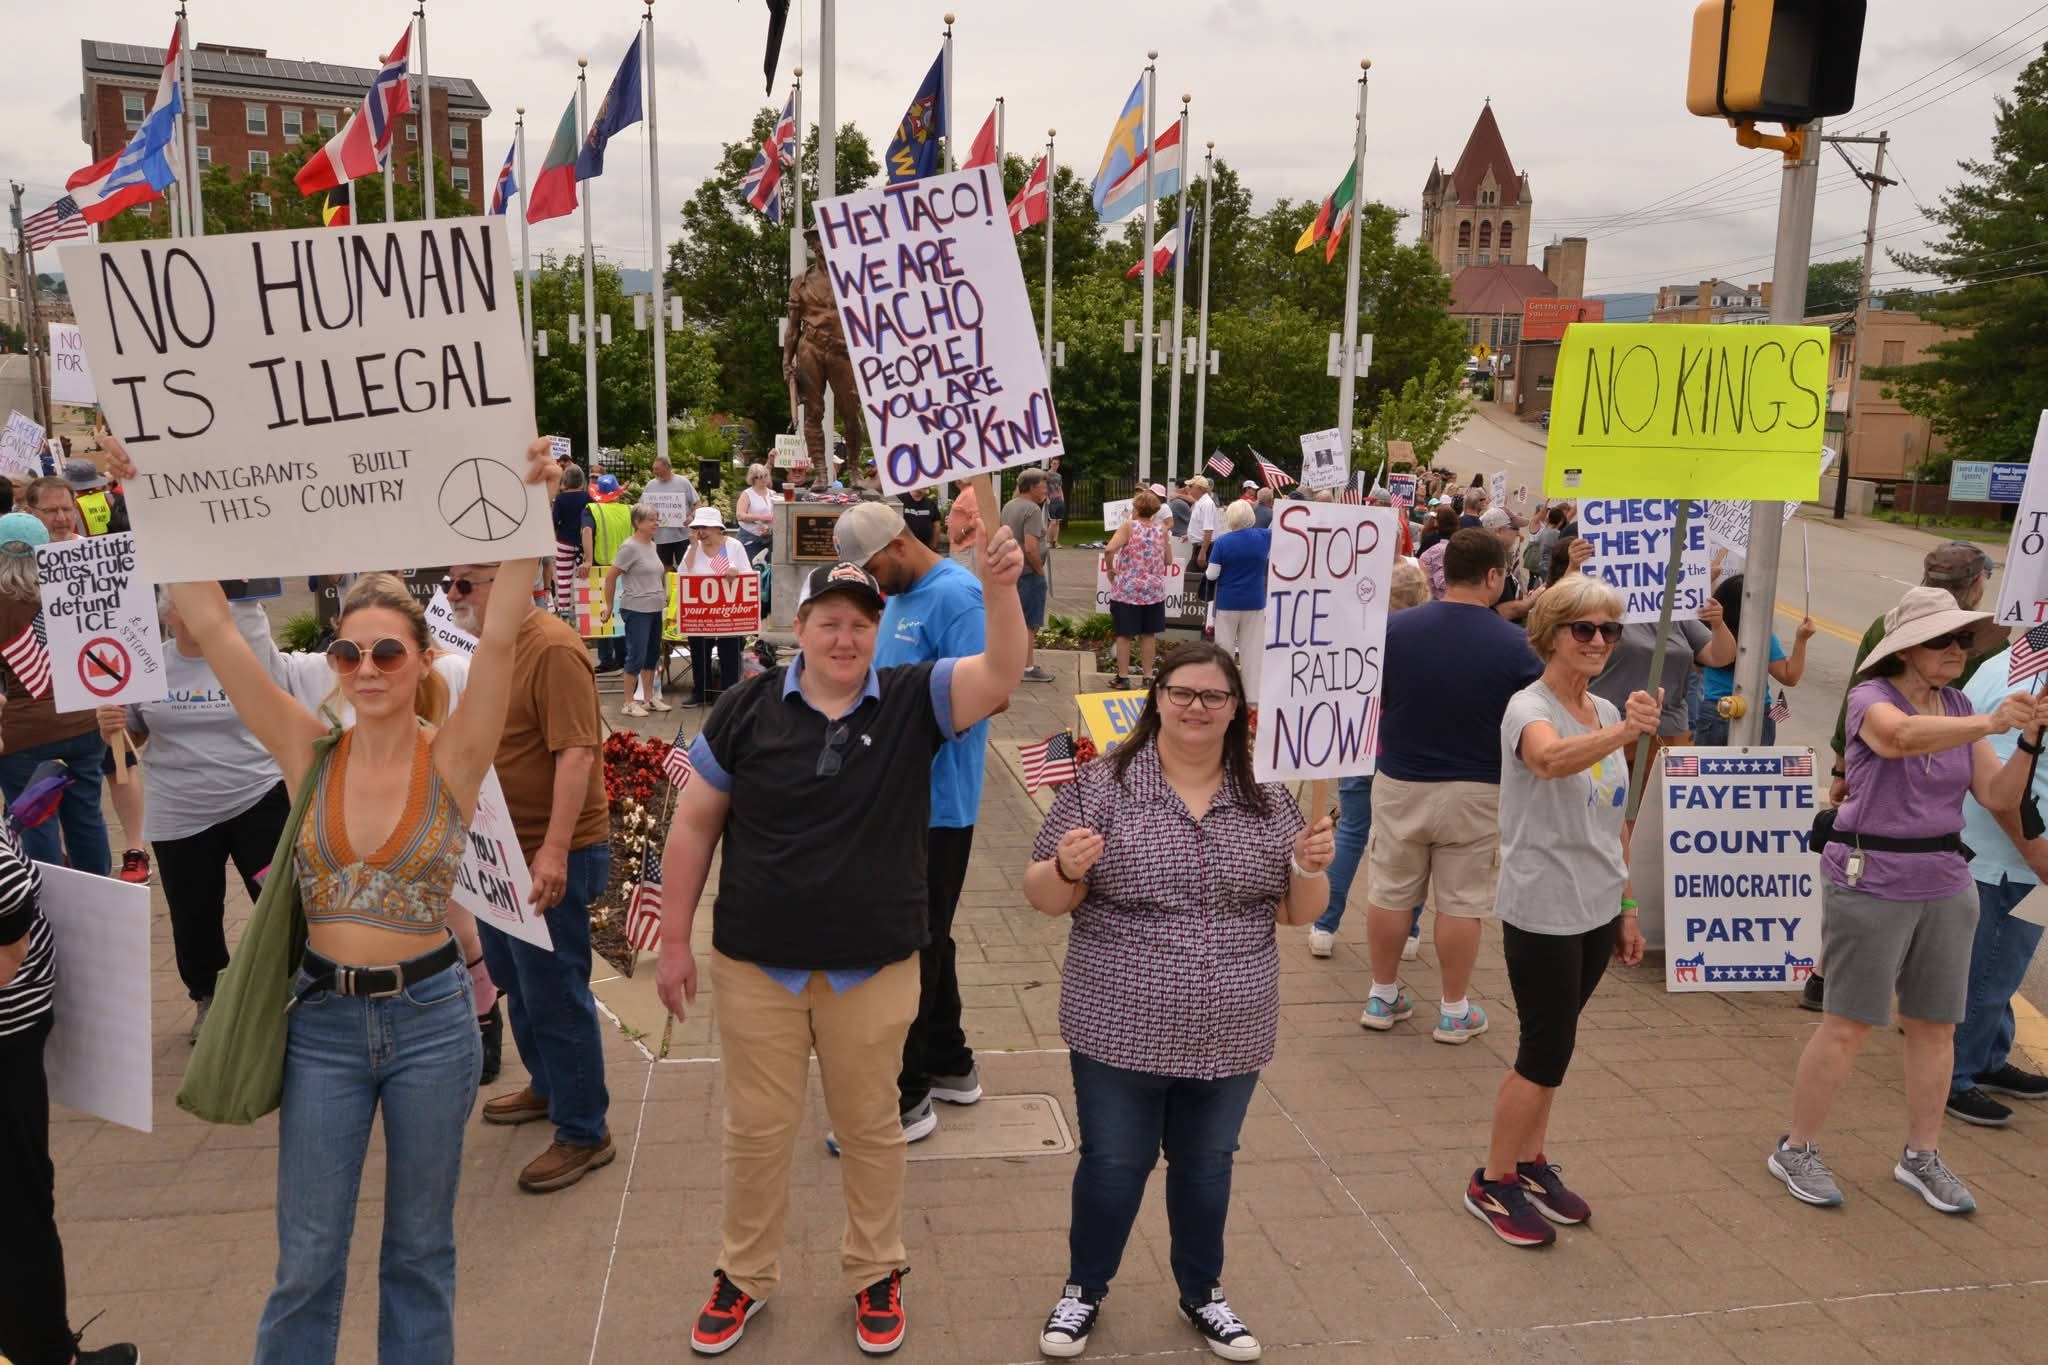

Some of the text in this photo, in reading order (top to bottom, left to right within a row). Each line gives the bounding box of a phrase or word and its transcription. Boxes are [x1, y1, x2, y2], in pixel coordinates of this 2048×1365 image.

[819, 168, 994, 249] HEY TACO!
[829, 237, 965, 299] WE ARE
[100, 225, 496, 354] NO HUMAN
[843, 279, 984, 353] NACHO
[60, 332, 83, 350] NO
[57, 353, 84, 373] FOR
[858, 327, 984, 396] PEOPLE!
[112, 341, 511, 444] IS ILLEGAL
[1578, 338, 1825, 437] NO KINGS
[867, 366, 1004, 447] YOU ARE
[917, 399, 980, 435] NOT
[887, 387, 1059, 487] OUR KING!
[142, 448, 413, 500] IMMIGRANTS BUILT
[200, 479, 404, 525] THIS COUNTRY
[1584, 499, 1710, 526] CHECKS!
[1271, 505, 1380, 582] STOP
[97, 554, 135, 576] rule
[1688, 563, 1706, 576] the
[67, 573, 129, 597] of law
[682, 577, 758, 604] LOVE
[50, 591, 120, 617] defund
[430, 604, 444, 618] NO
[682, 607, 708, 618] your
[76, 611, 119, 633] ICE
[1265, 589, 1333, 650] ICE
[438, 629, 477, 654] CLOWNS
[1291, 646, 1379, 698] RAIDS
[1669, 784, 1815, 810] FAYETTE
[1669, 829, 1812, 855] COUNTY
[1674, 872, 1813, 899] DEMOCRATIC
[1686, 917, 1802, 943] PARTY
